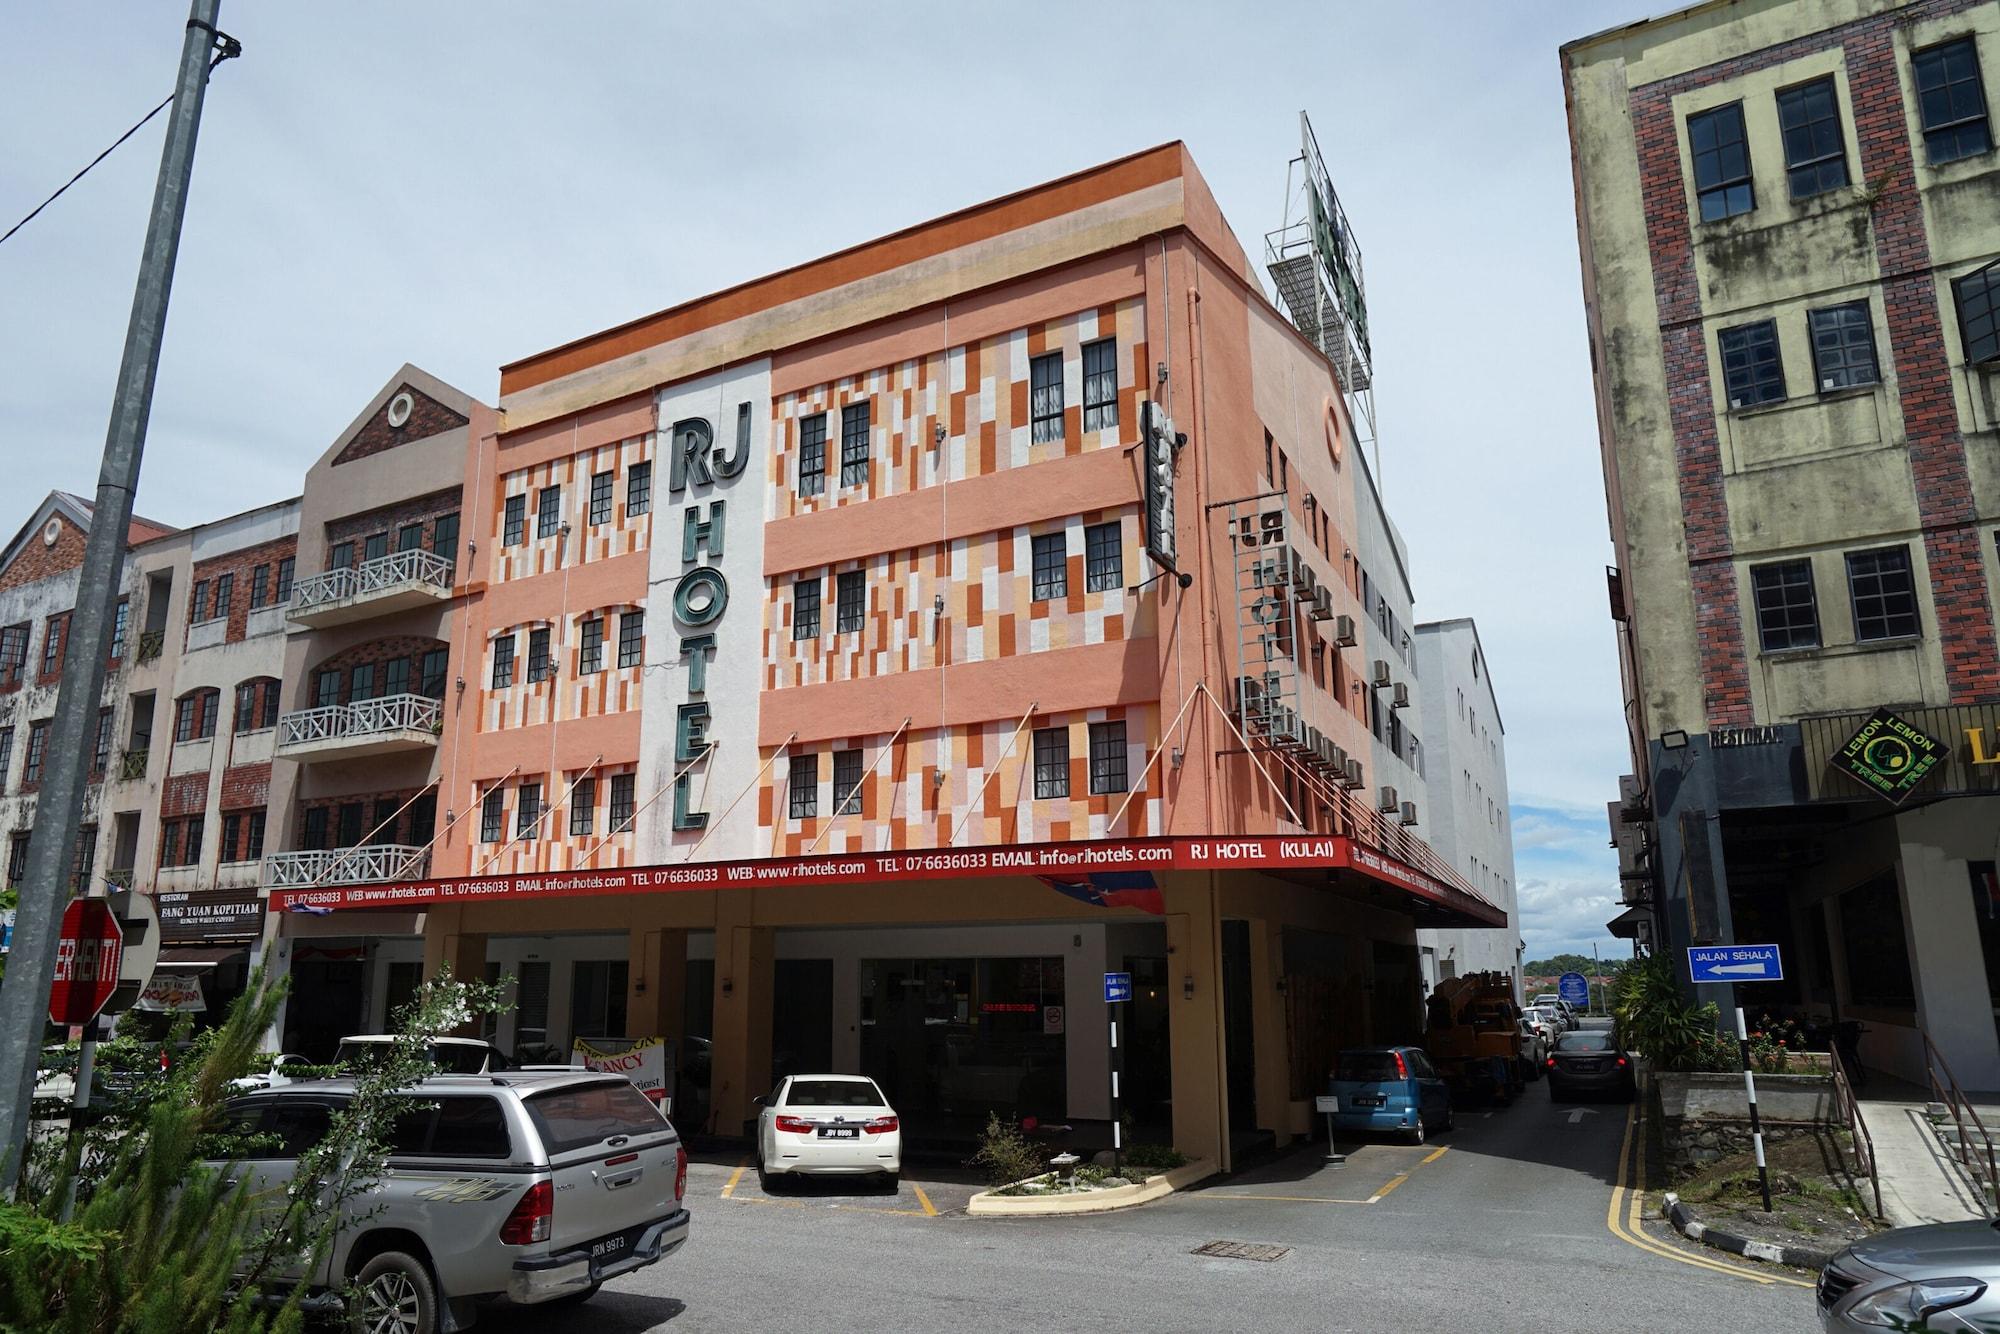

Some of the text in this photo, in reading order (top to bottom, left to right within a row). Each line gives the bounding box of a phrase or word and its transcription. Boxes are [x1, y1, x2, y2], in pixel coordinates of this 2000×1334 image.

[669, 401, 751, 493] RJ
[672, 499, 730, 832] HOTEL
[1843, 718, 1883, 758] LEMON
[1886, 717, 1936, 751] LEMON
[1850, 759, 1895, 792] TREE
[1897, 754, 1938, 789] TREE
[1190, 843, 1208, 860] RJ
[1216, 843, 1266, 859] HOTEL
[1280, 841, 1334, 858] (KULAI)
[161, 903, 259, 918] FANG YUAN KOPITIAM
[53, 938, 116, 982] ERHENTI
[1696, 950, 1773, 961] JALAN SEHALA
[591, 1236, 625, 1257] JRN 9973
